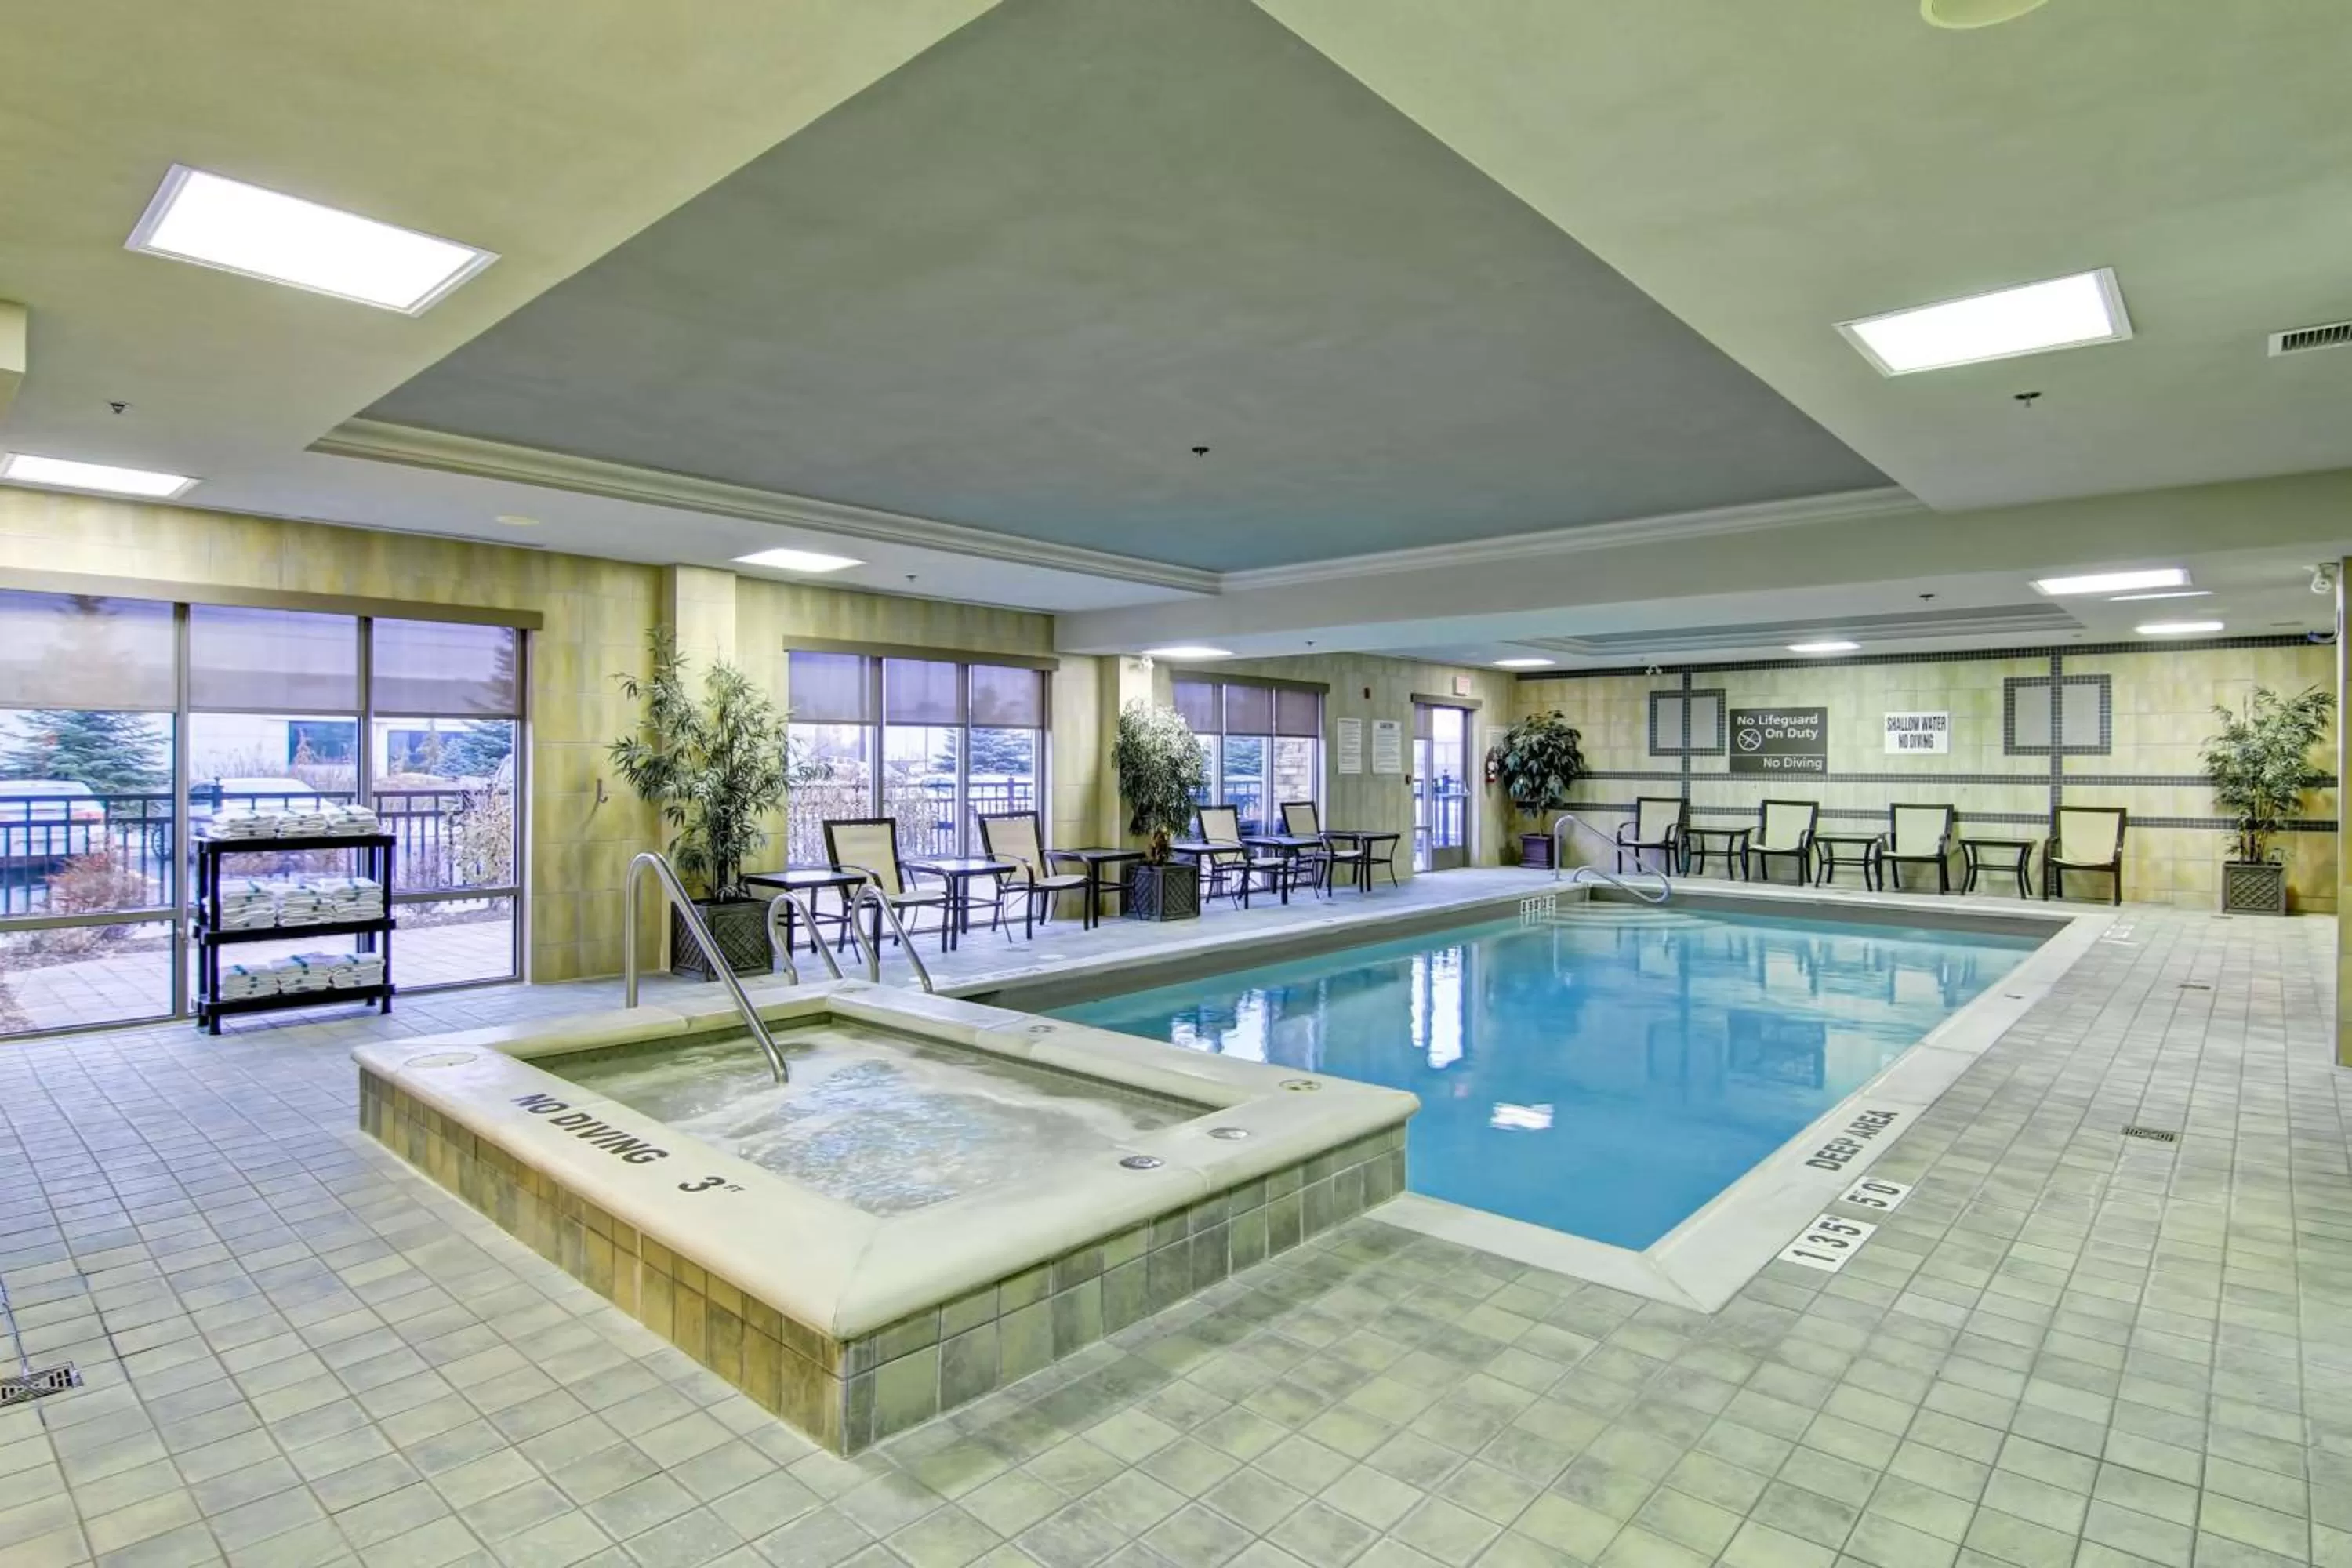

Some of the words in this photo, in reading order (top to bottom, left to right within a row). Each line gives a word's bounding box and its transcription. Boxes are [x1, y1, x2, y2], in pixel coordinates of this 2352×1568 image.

[1737, 714, 1755, 725] No
[1759, 713, 1818, 728] Lifeguard
[1886, 716, 1919, 731] SHALLOW
[1921, 716, 1946, 731] WATER
[1765, 728, 1784, 739] On
[1787, 728, 1819, 740] Duty
[1898, 734, 1908, 748] NO
[1909, 733, 1934, 748] DIVING
[1763, 757, 1780, 768] No
[1784, 757, 1823, 771] Diving
[510, 1093, 570, 1114] NO
[548, 1112, 670, 1164] DIVING
[1805, 1137, 1864, 1171] DEEP
[1842, 1109, 1900, 1140] AREA
